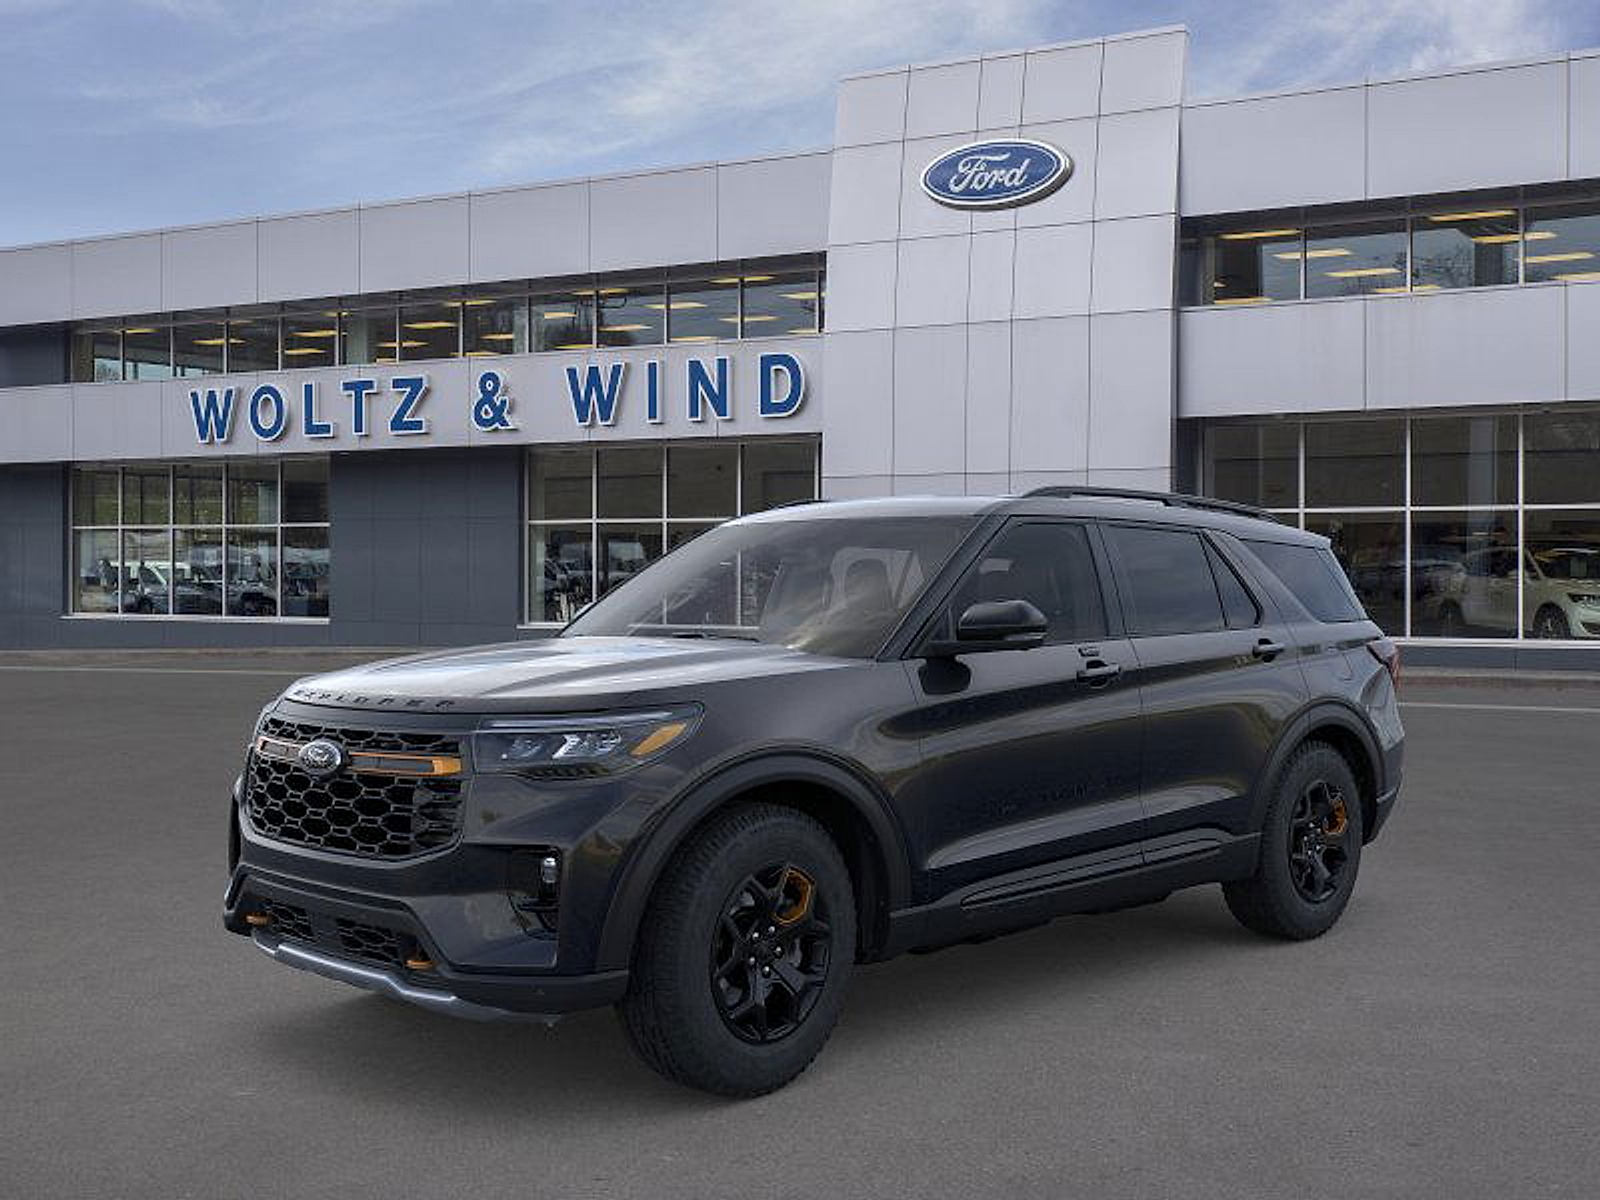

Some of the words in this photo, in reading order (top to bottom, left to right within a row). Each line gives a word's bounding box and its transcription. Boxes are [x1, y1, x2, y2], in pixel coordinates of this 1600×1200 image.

[950, 153, 1031, 193] Ford
[190, 376, 429, 444] WOLTZ
[470, 370, 513, 431] &
[565, 351, 805, 426] WIND
